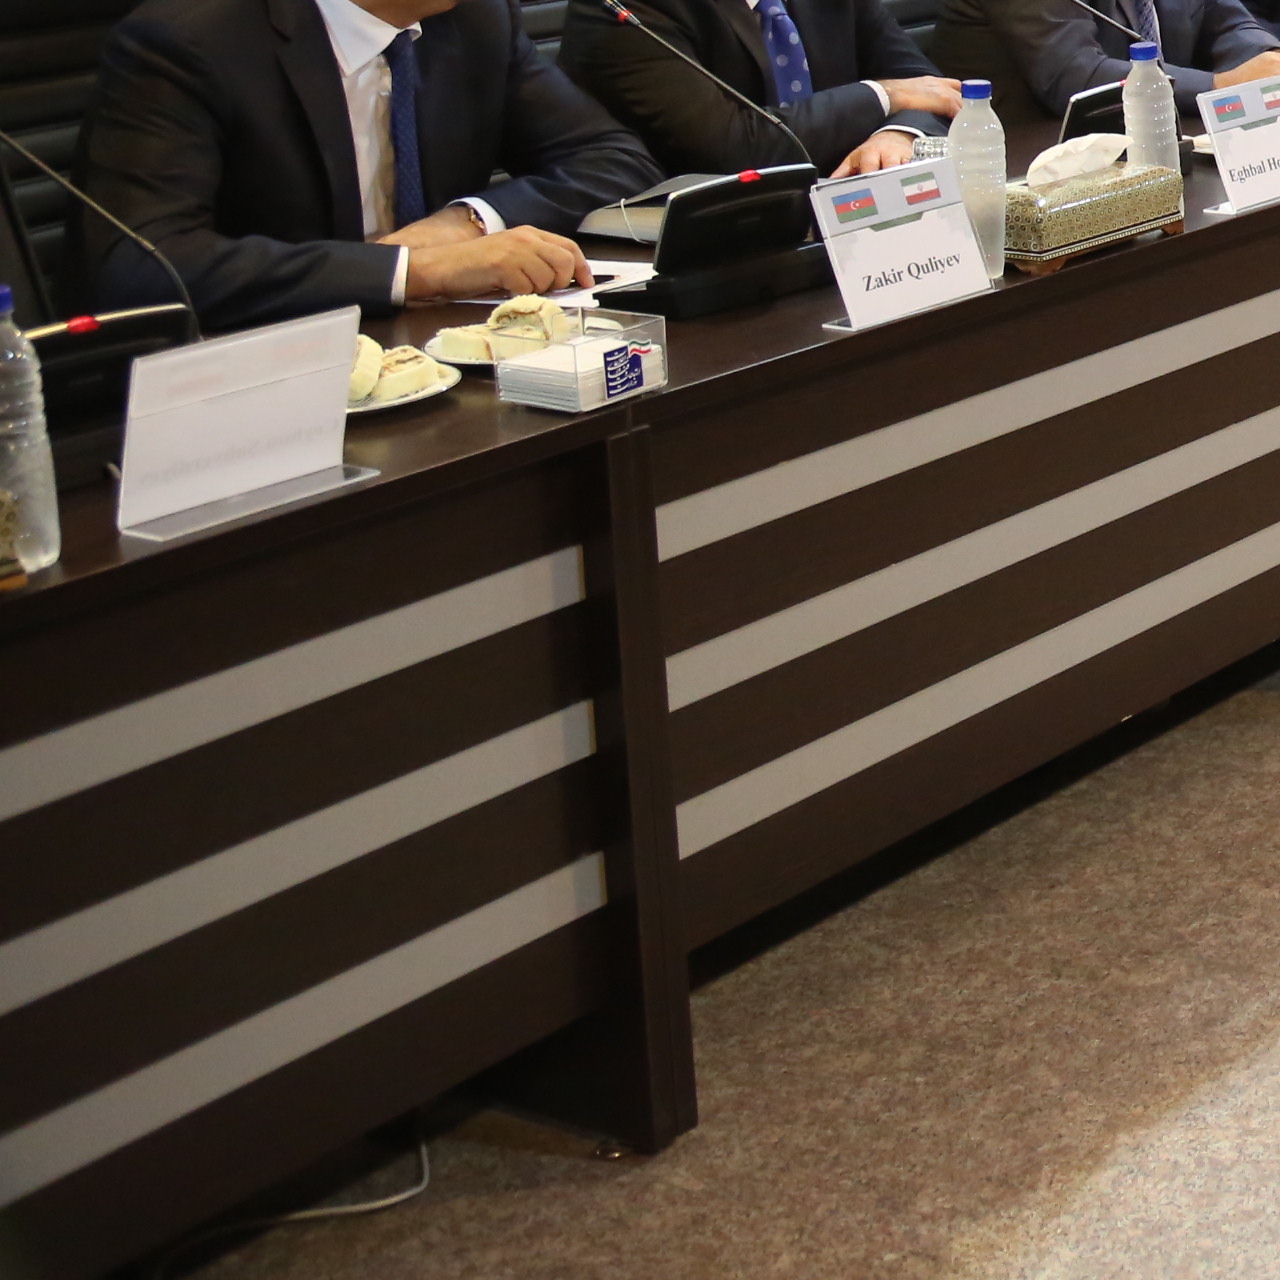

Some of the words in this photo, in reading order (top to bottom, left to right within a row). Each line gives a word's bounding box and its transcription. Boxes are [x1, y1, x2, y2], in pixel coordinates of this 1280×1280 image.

[1228, 161, 1267, 183] Eghbal
[862, 268, 905, 292] Zakir
[907, 253, 961, 280] Quliyev
